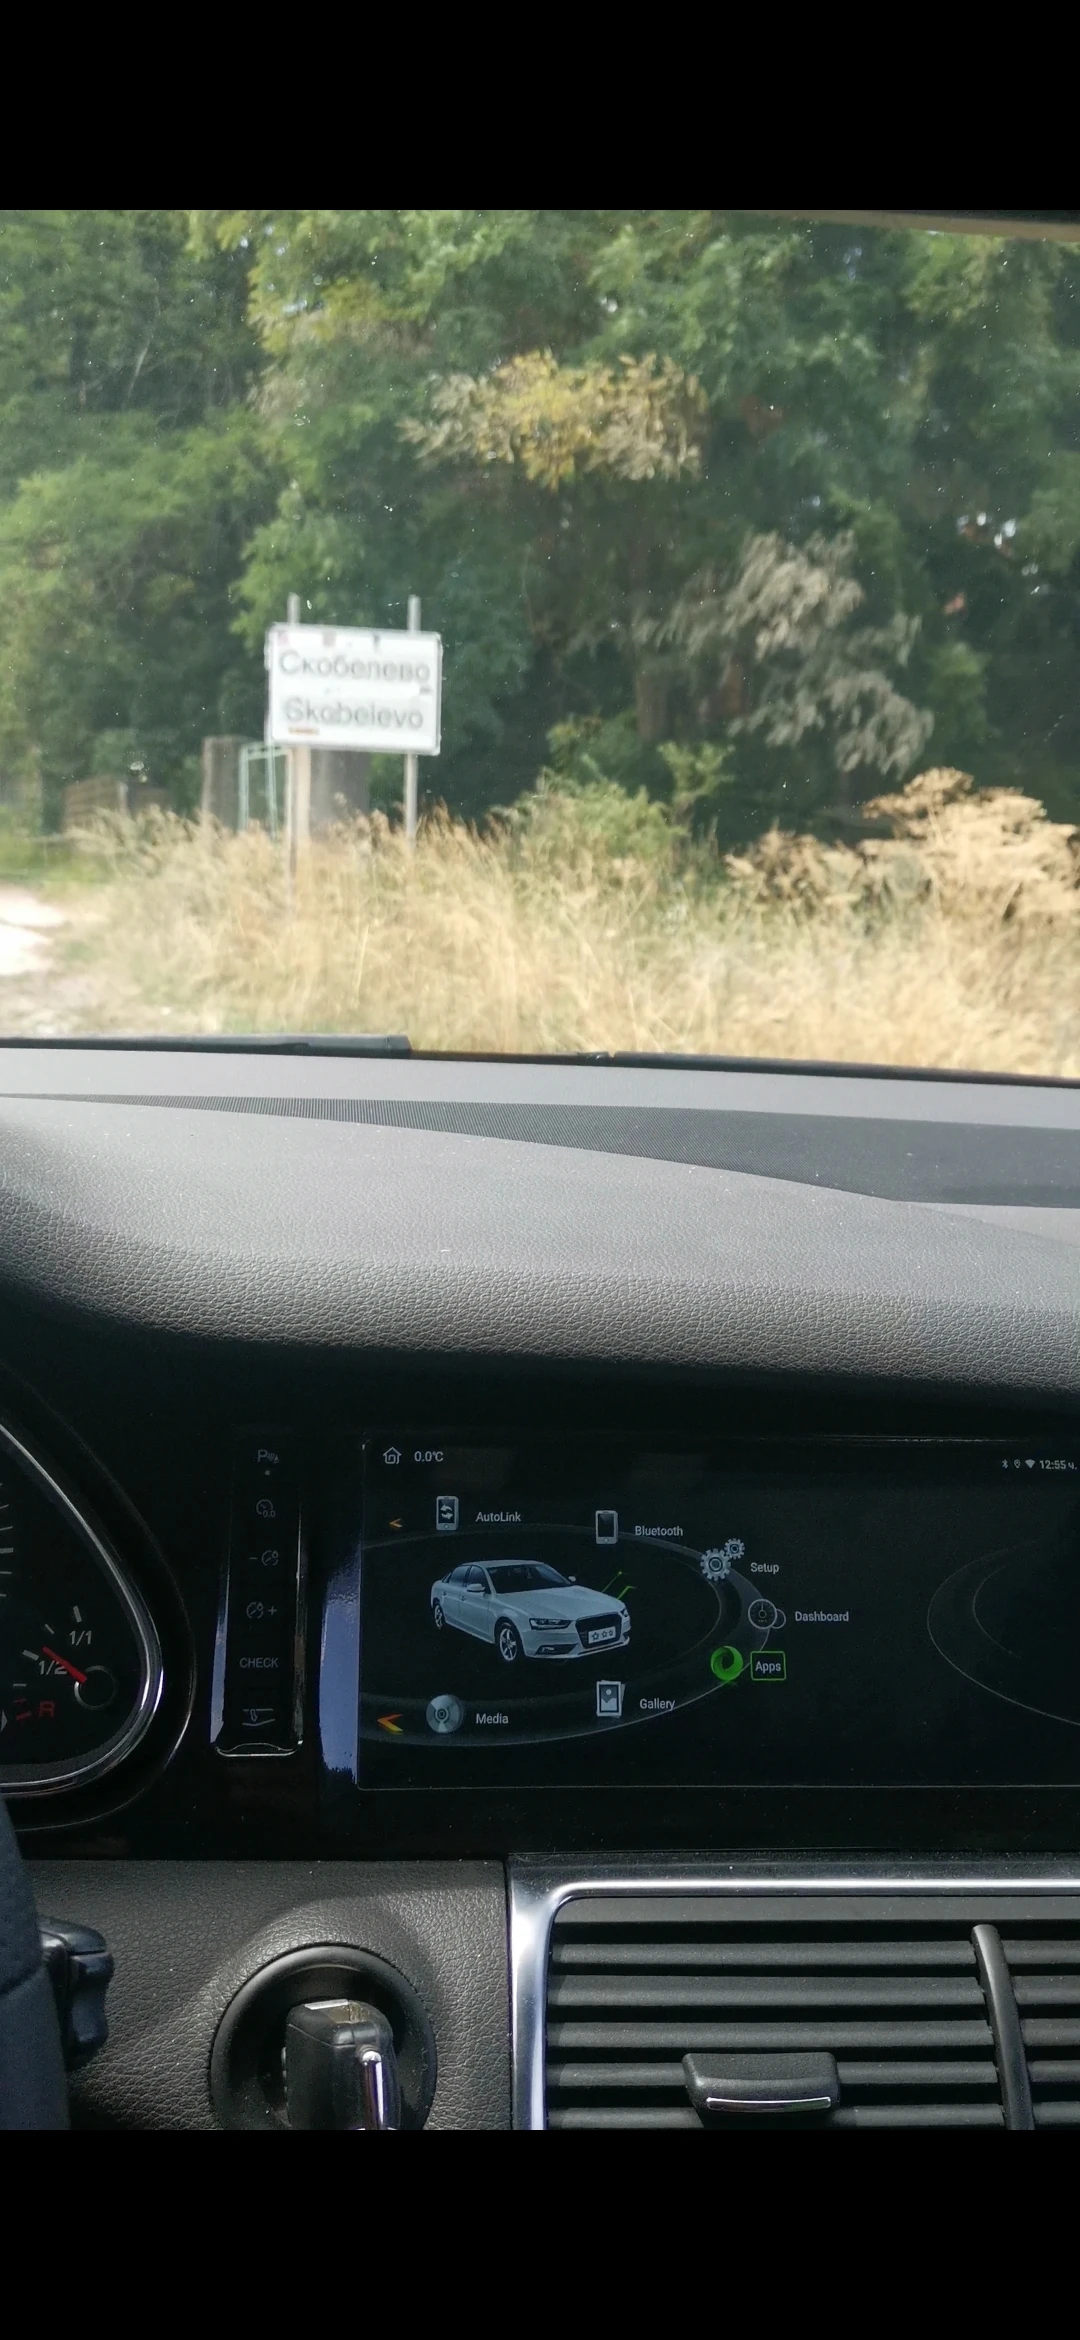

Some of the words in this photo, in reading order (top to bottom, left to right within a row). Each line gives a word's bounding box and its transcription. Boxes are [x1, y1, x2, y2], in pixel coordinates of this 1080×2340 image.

[279, 649, 431, 683] Скобелево
[284, 697, 424, 731] Skobelevo
[1040, 1459, 1066, 1470] 12:55
[475, 1511, 522, 1523] AutoLink
[634, 1525, 684, 1537] Bluetooth
[750, 1562, 780, 1574] Setup
[794, 1611, 850, 1622] Dashboard
[69, 1630, 92, 1646] 1/1
[239, 1657, 279, 1669] CHECK
[755, 1660, 782, 1673] Apps
[639, 1697, 676, 1711] Gallery
[475, 1713, 509, 1725] Media
